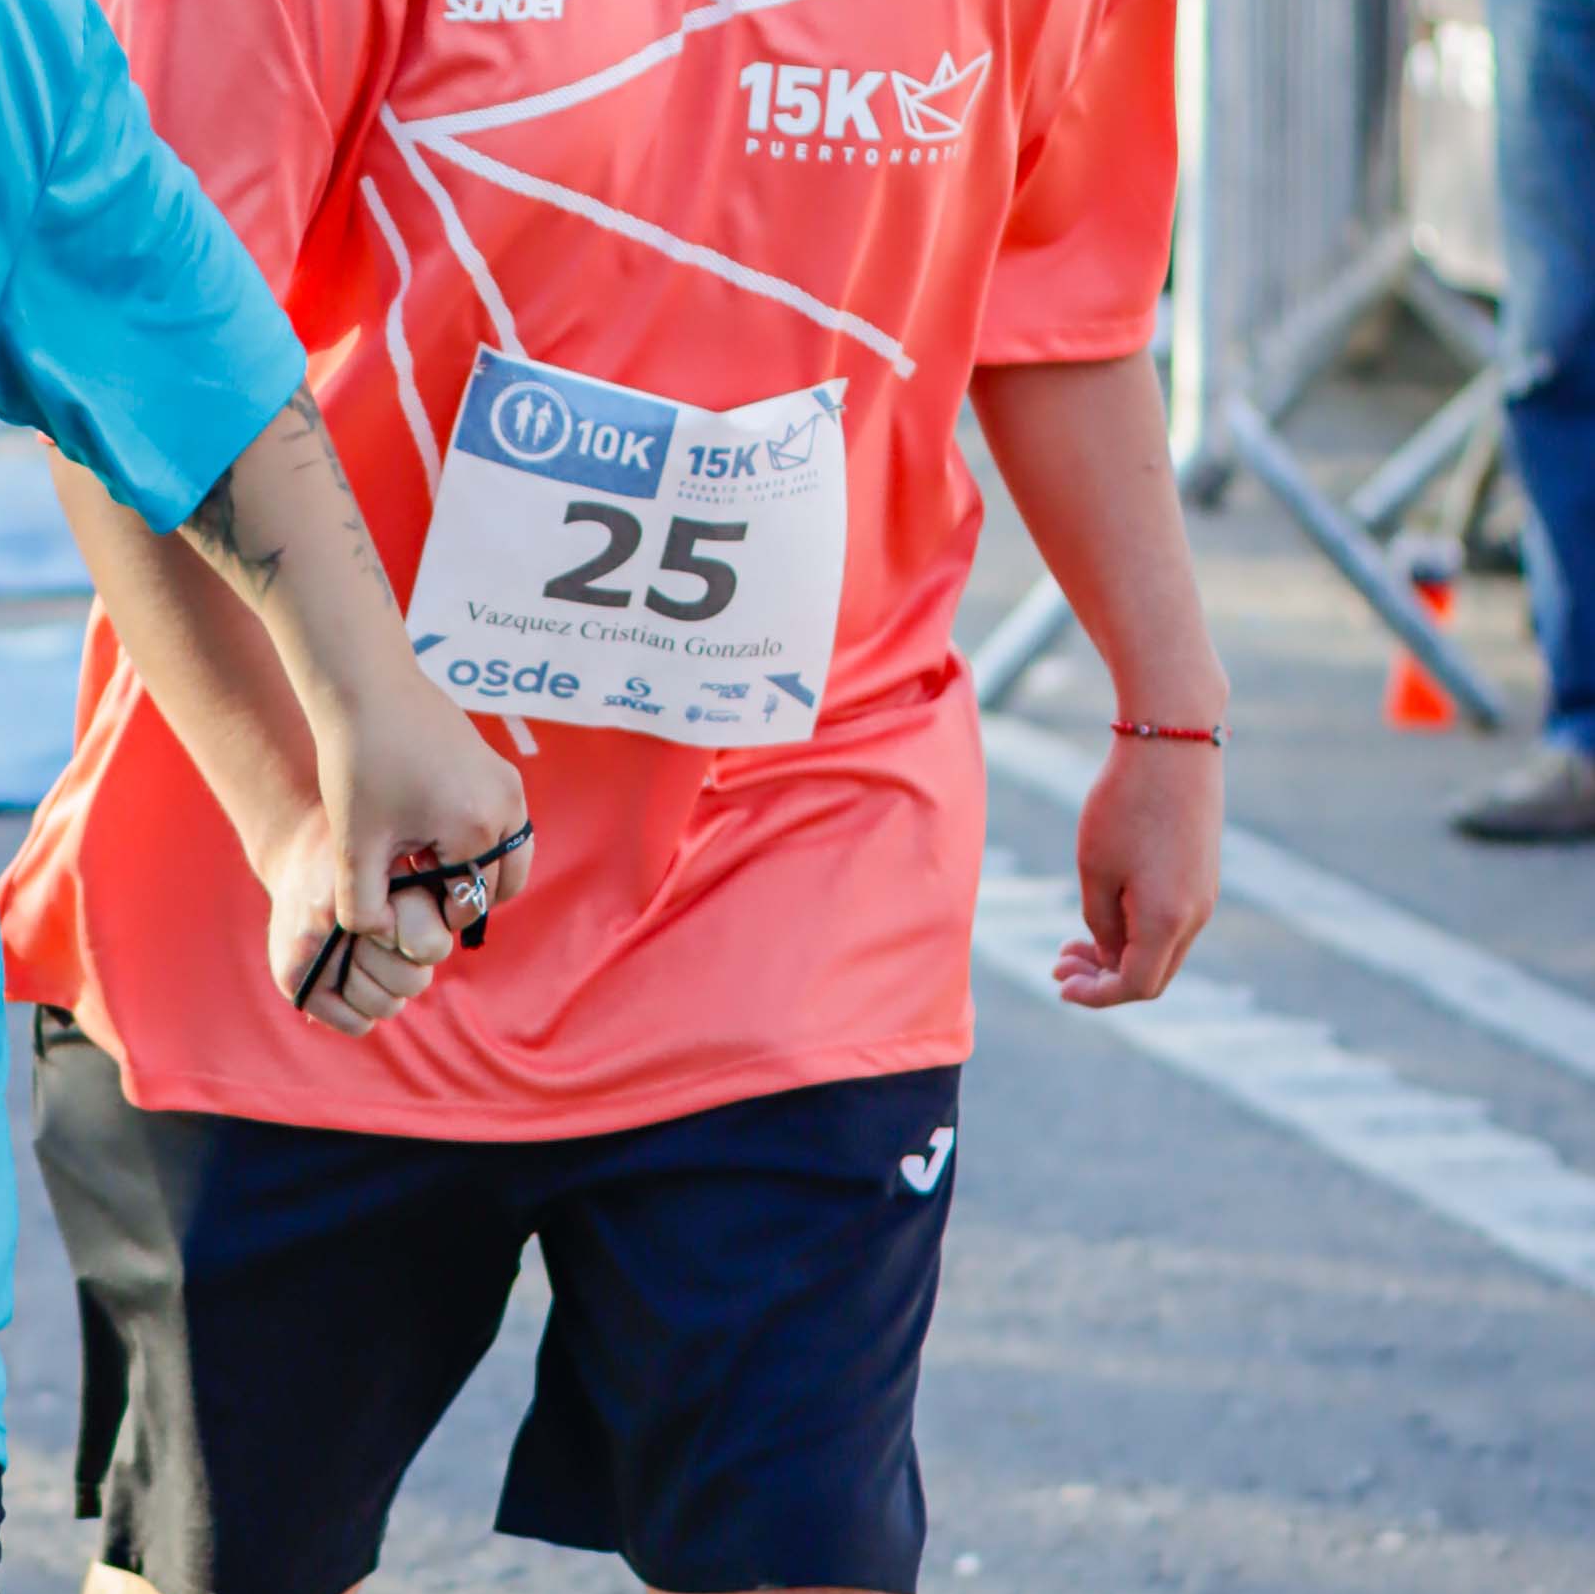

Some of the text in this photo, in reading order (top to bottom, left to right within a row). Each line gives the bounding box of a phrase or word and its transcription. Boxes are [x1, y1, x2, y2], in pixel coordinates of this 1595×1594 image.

[739, 61, 886, 140] 15K
[578, 420, 655, 470] 10K
[687, 443, 759, 480] 15K
[543, 500, 748, 622] 25
[467, 600, 783, 660] Vazquez Cristian Gonzalo
[447, 659, 580, 700] osde
